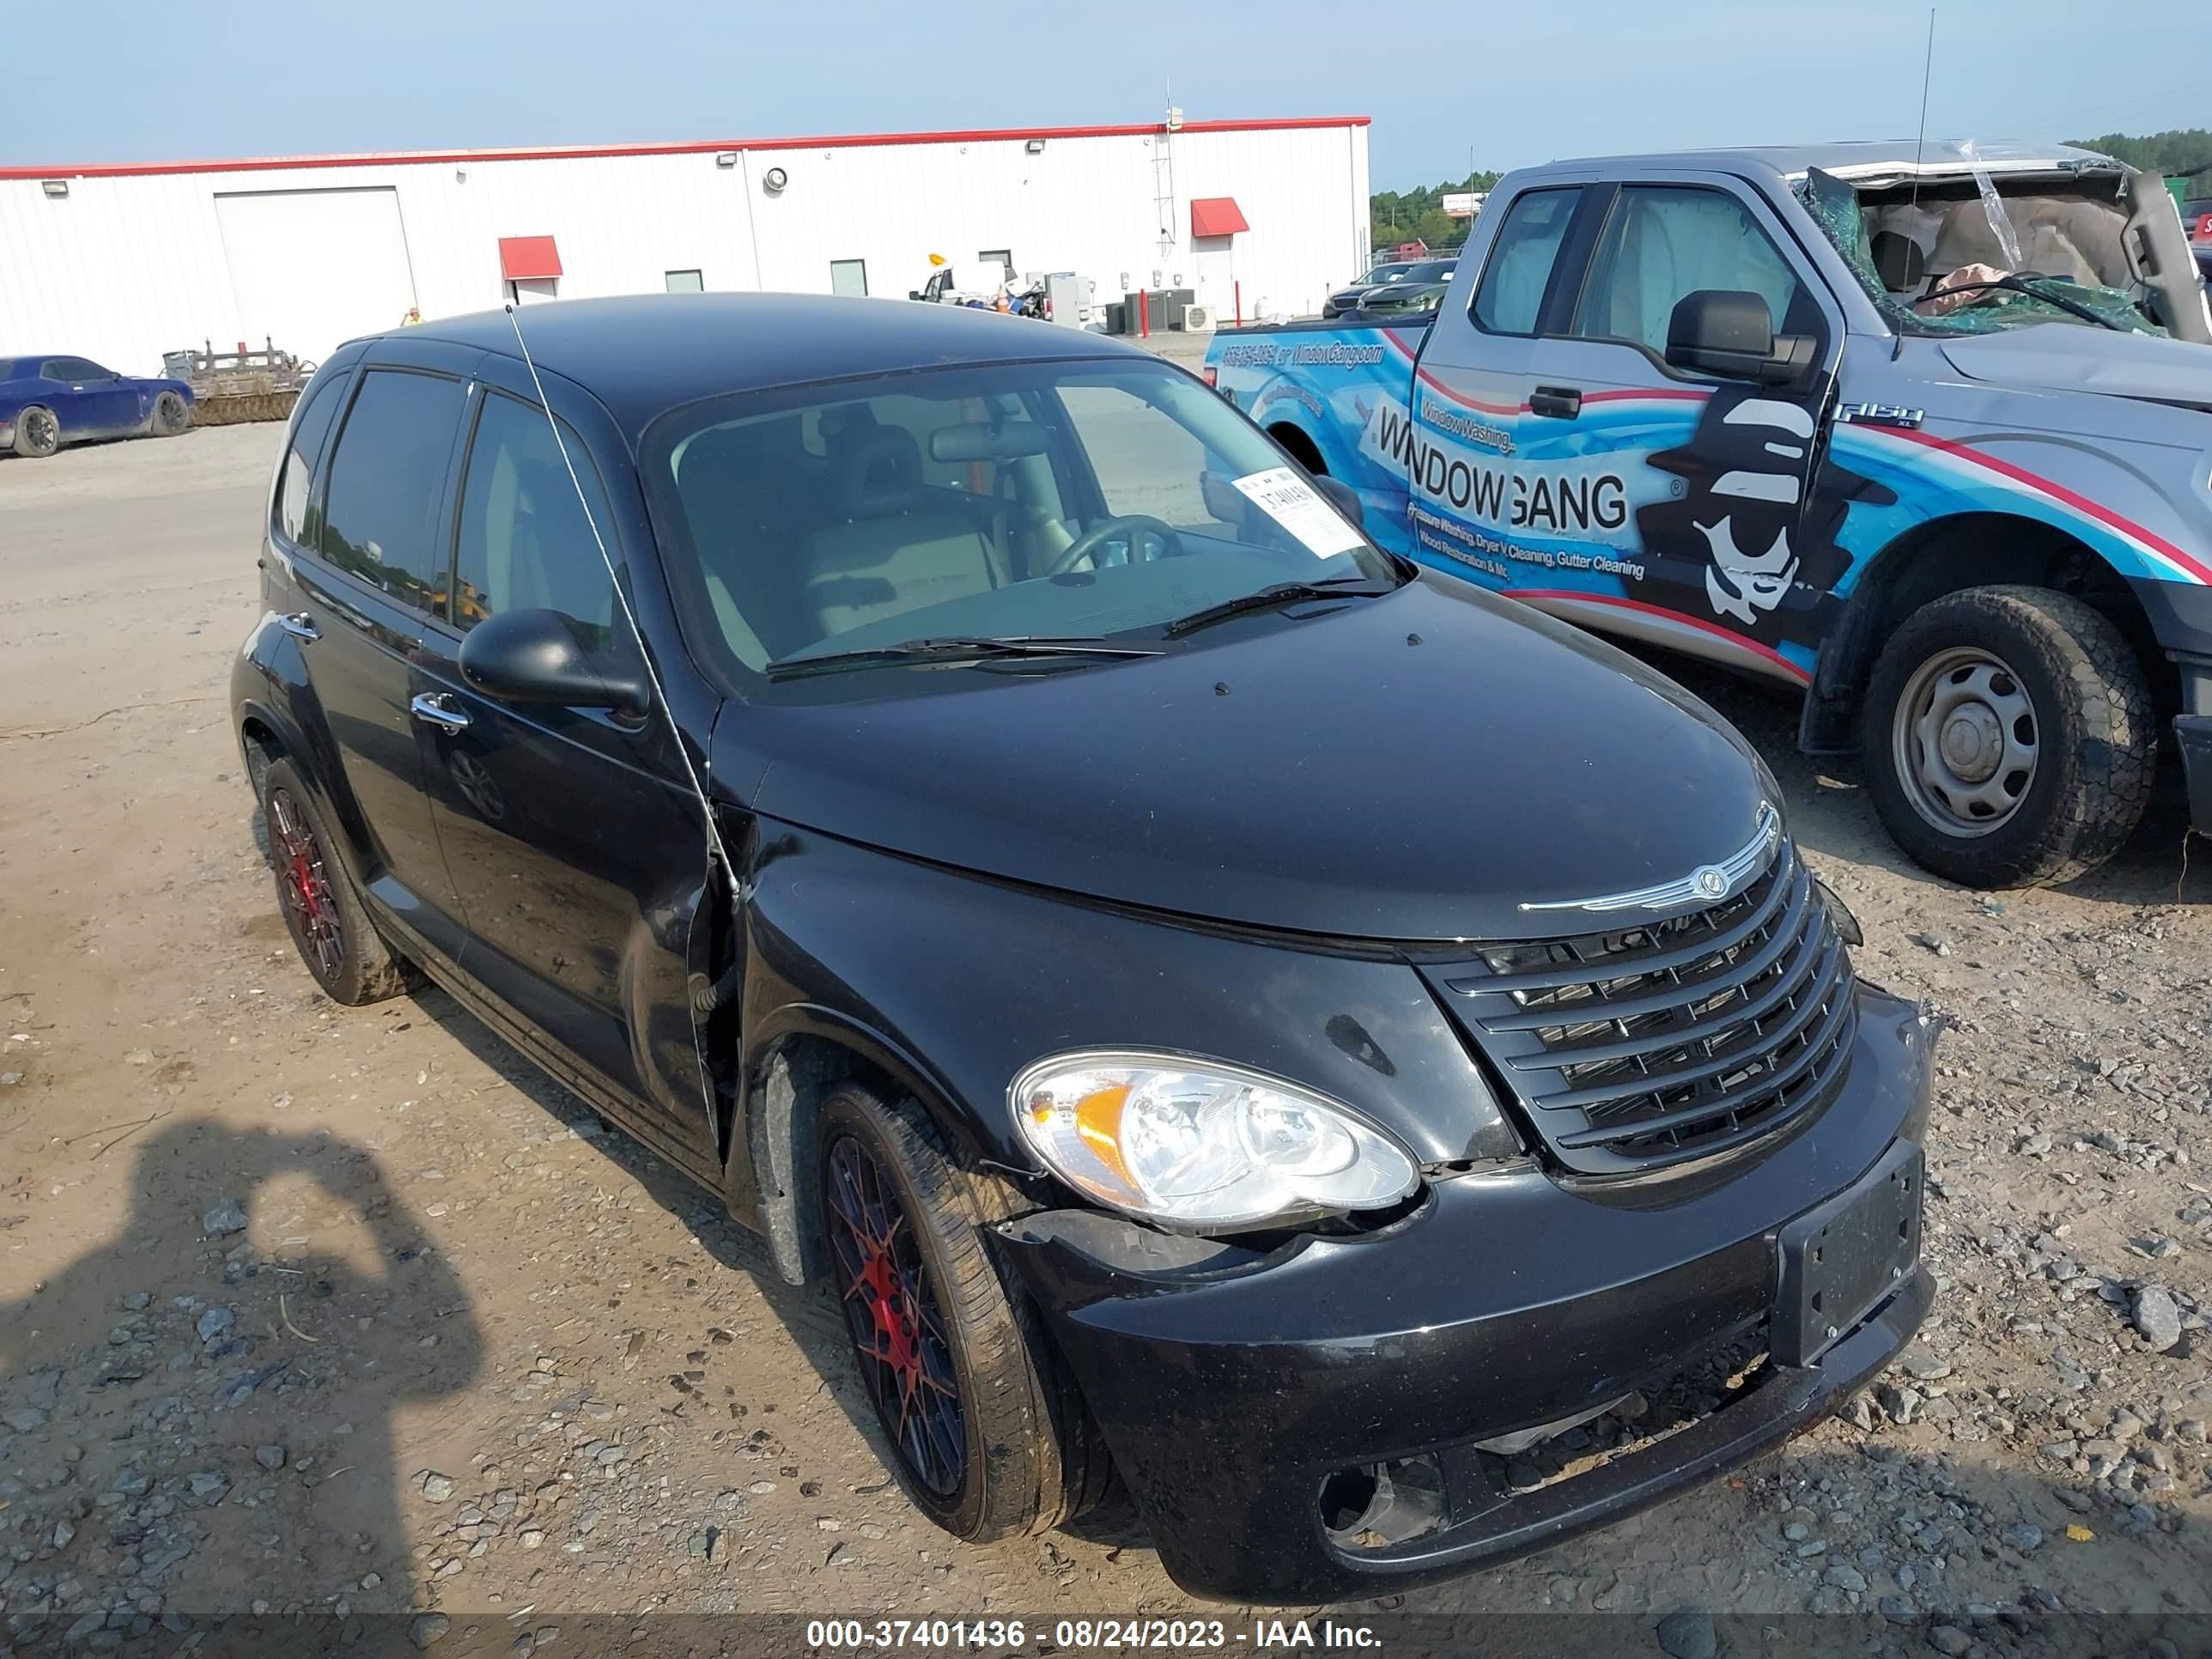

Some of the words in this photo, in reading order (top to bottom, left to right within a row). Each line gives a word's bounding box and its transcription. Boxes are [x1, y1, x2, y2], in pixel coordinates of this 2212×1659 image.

[1422, 398, 1465, 435] Window
[1511, 474, 1626, 529] GANG
[1407, 501, 1441, 529] Pressure
[1476, 534, 1500, 553] Dryer
[1557, 550, 1592, 569] Gutter
[1593, 556, 1645, 580] Cleaning
[1419, 528, 1442, 550] Wood
[1442, 541, 1486, 571] Restoration
[1487, 561, 1495, 574] &
